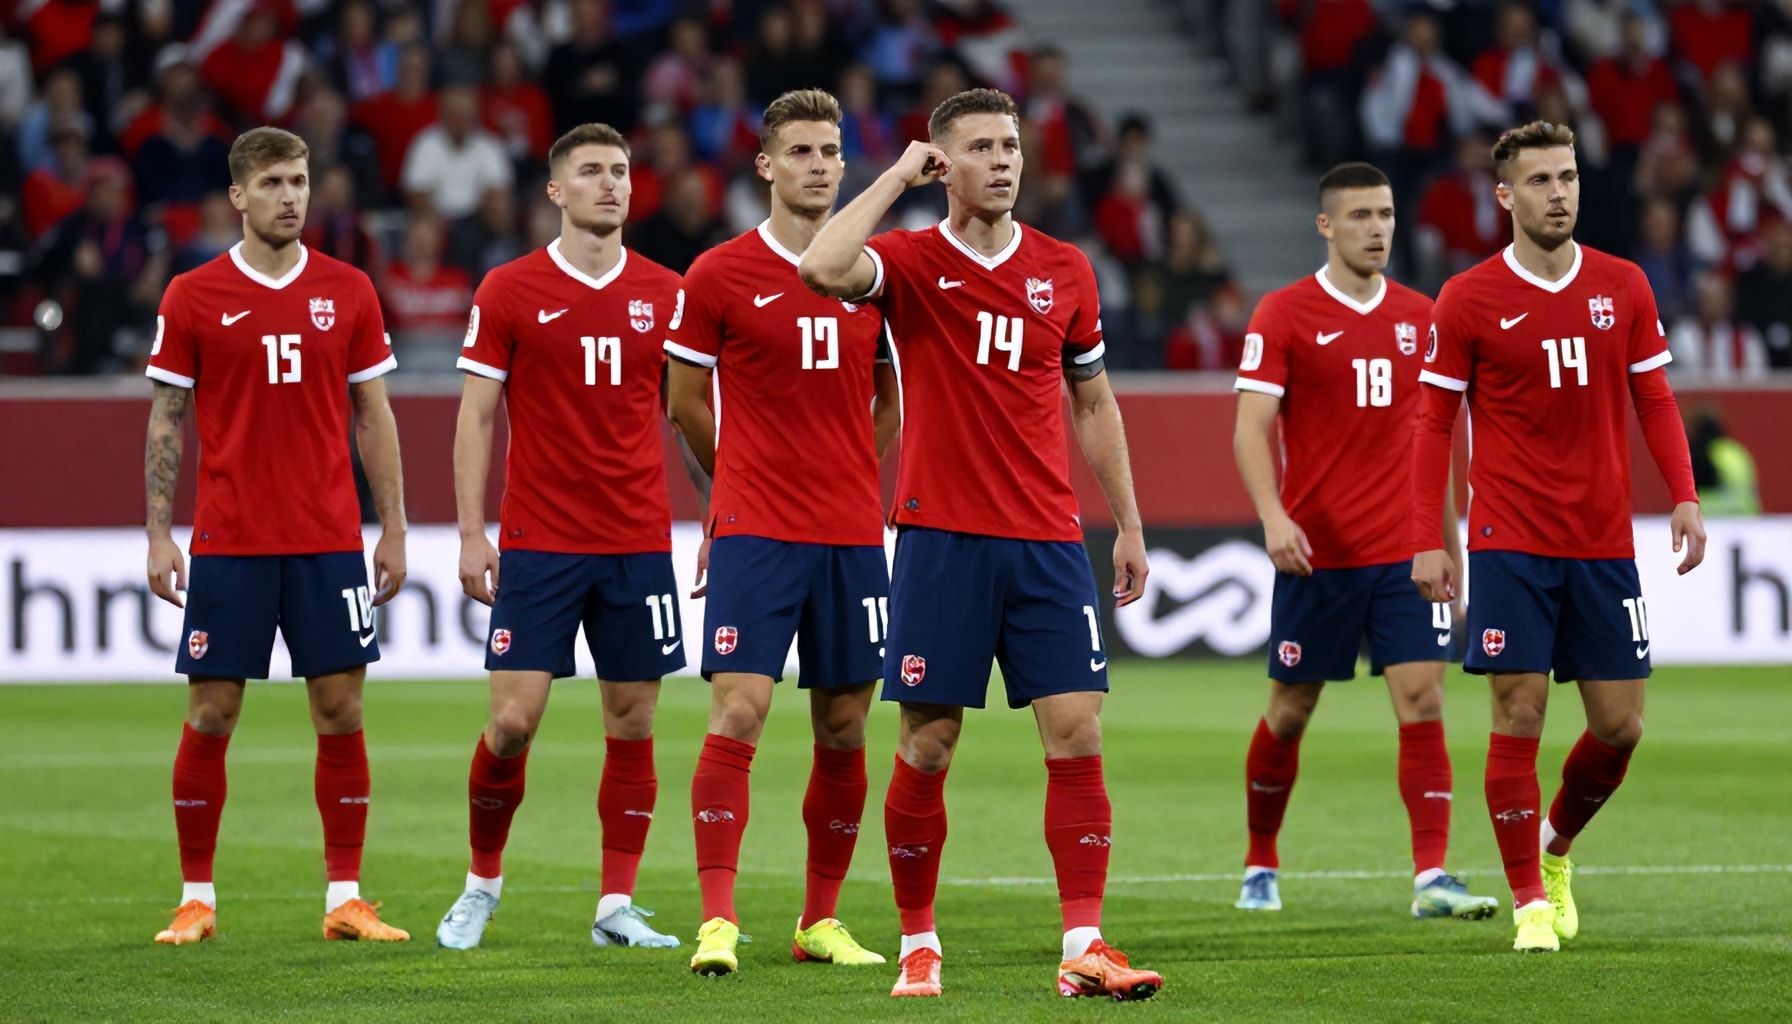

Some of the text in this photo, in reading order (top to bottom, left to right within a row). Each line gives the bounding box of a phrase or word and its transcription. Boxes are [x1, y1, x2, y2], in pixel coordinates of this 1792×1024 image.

[261, 333, 302, 385] 15
[976, 310, 1025, 372] 14
[1541, 336, 1589, 389] 14
[1351, 357, 1393, 408] 18
